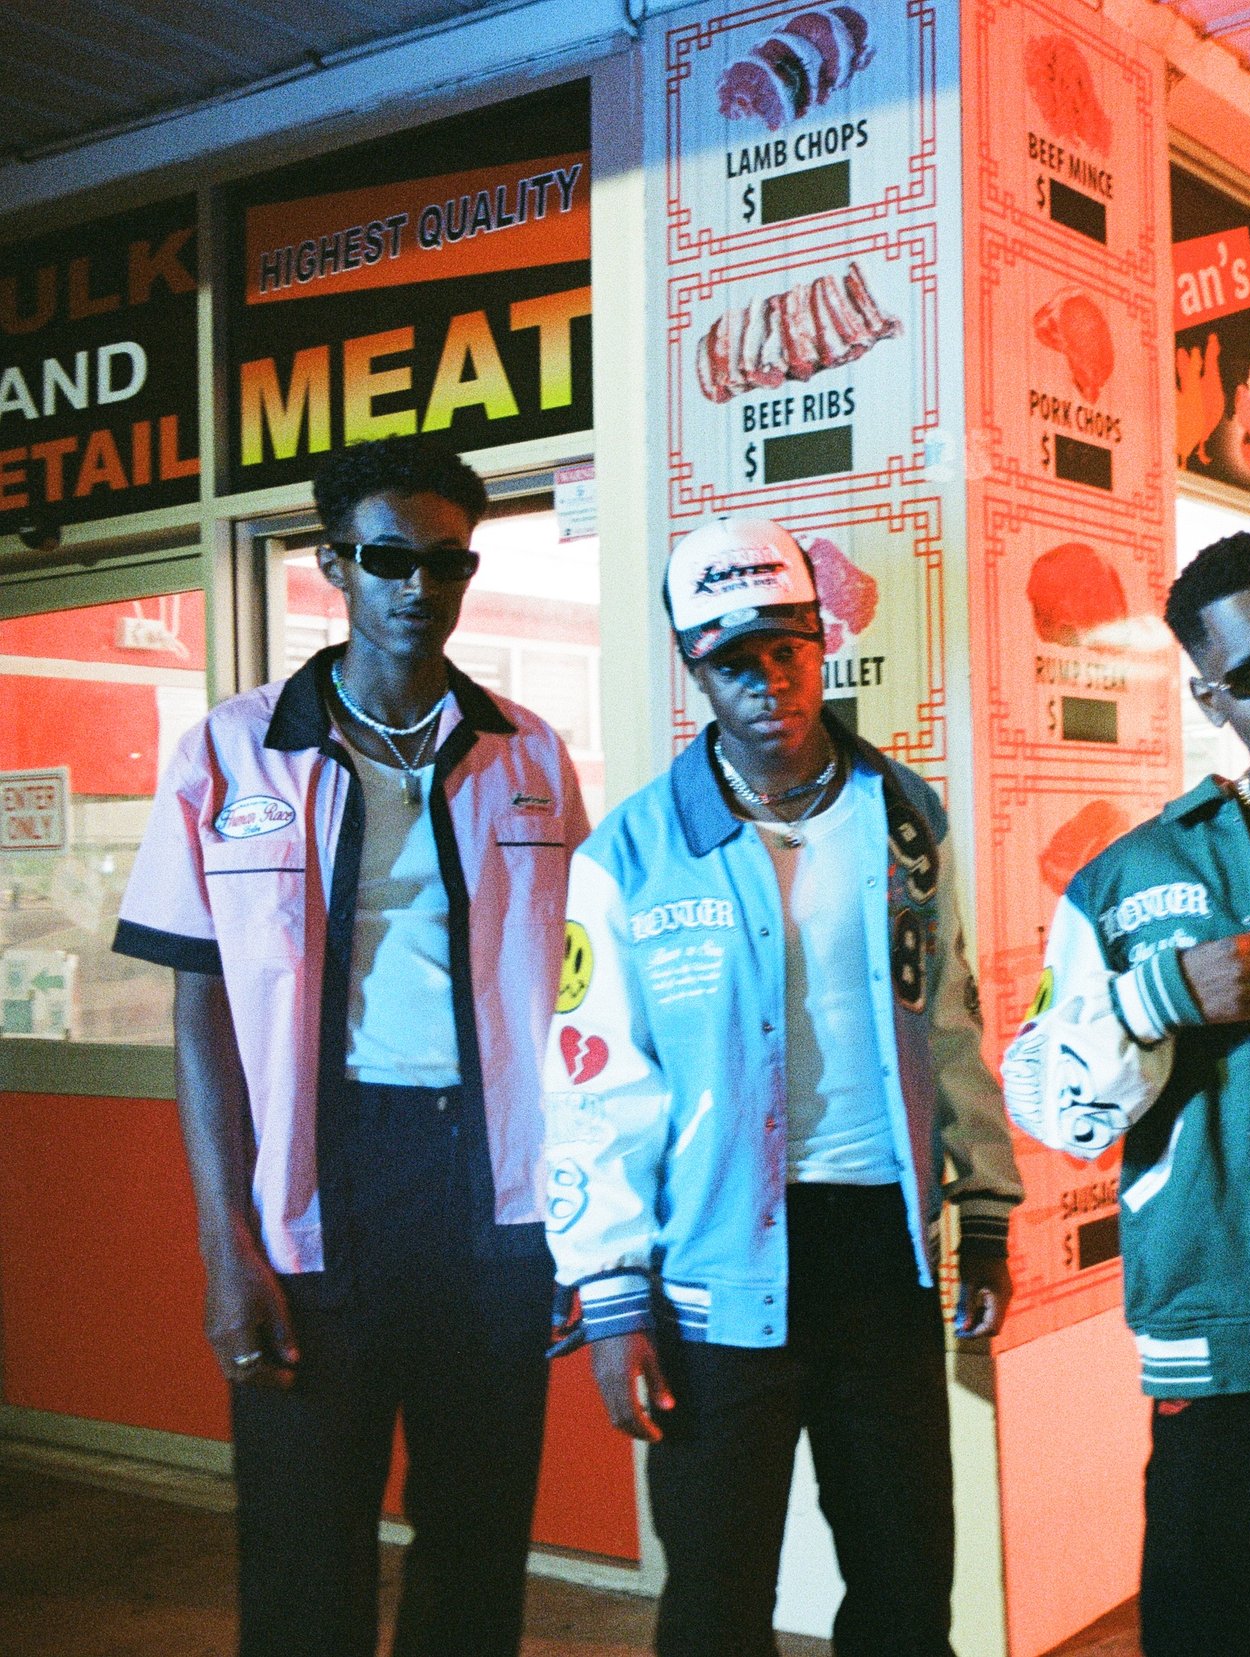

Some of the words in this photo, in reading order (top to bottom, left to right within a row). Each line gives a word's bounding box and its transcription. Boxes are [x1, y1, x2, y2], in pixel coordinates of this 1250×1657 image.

[726, 138, 787, 179] LAMB
[794, 119, 868, 161] CHOPS
[1027, 131, 1064, 174] BEEF
[1069, 153, 1114, 200] MINCE
[258, 212, 409, 295] HIGHEST
[417, 163, 583, 251] QUALITY
[742, 183, 756, 223] $
[0, 227, 197, 334] ULK
[0, 341, 148, 420] AND
[240, 285, 592, 466] MEAT
[742, 397, 795, 432] BEEF
[803, 387, 856, 423] RIBS
[1030, 389, 1072, 428] PORK
[1076, 405, 1123, 443] CHOPS
[0, 414, 201, 511] ETAIL
[744, 442, 758, 483] $
[823, 656, 885, 690] ILLET
